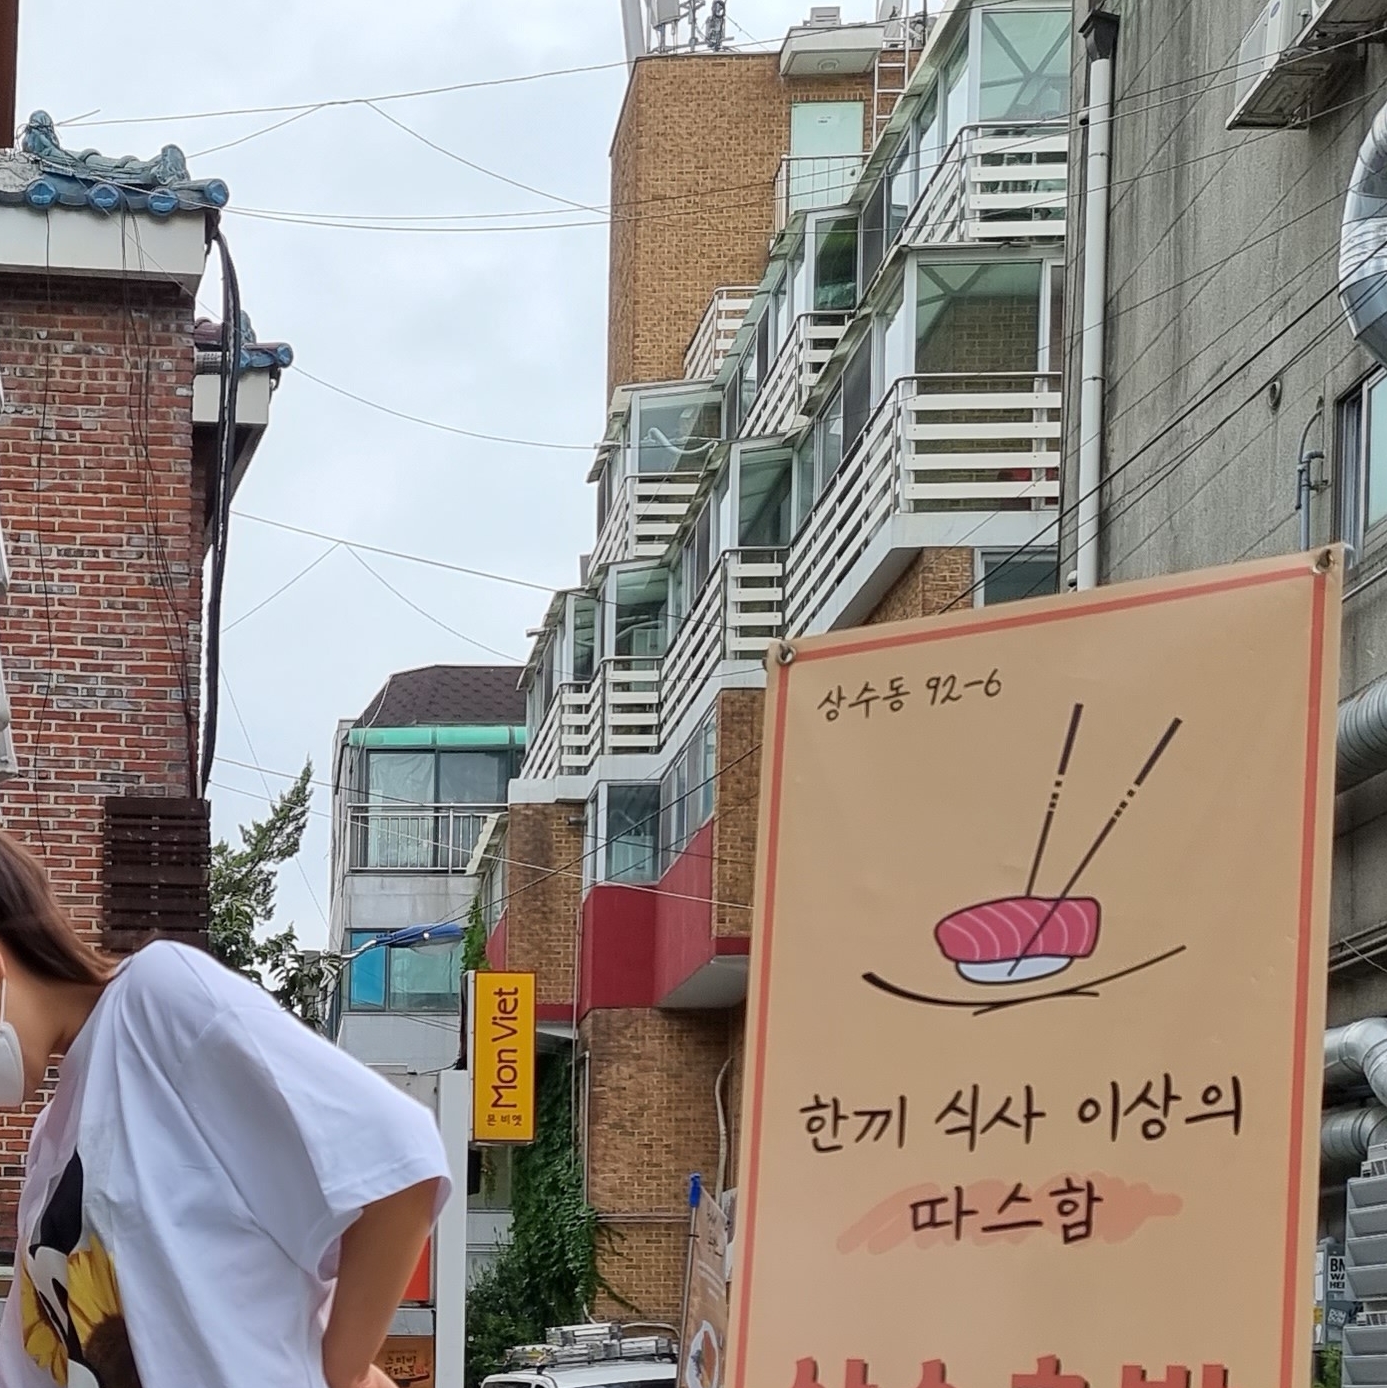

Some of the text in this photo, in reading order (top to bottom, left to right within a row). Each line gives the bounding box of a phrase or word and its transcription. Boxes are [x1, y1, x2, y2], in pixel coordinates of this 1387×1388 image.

[817, 668, 1003, 722] 상수동 92-6
[490, 986, 519, 1108] Mon Viet
[798, 1072, 1244, 1154] 한끼 식사 이상의
[910, 1177, 1104, 1244] 따스함
